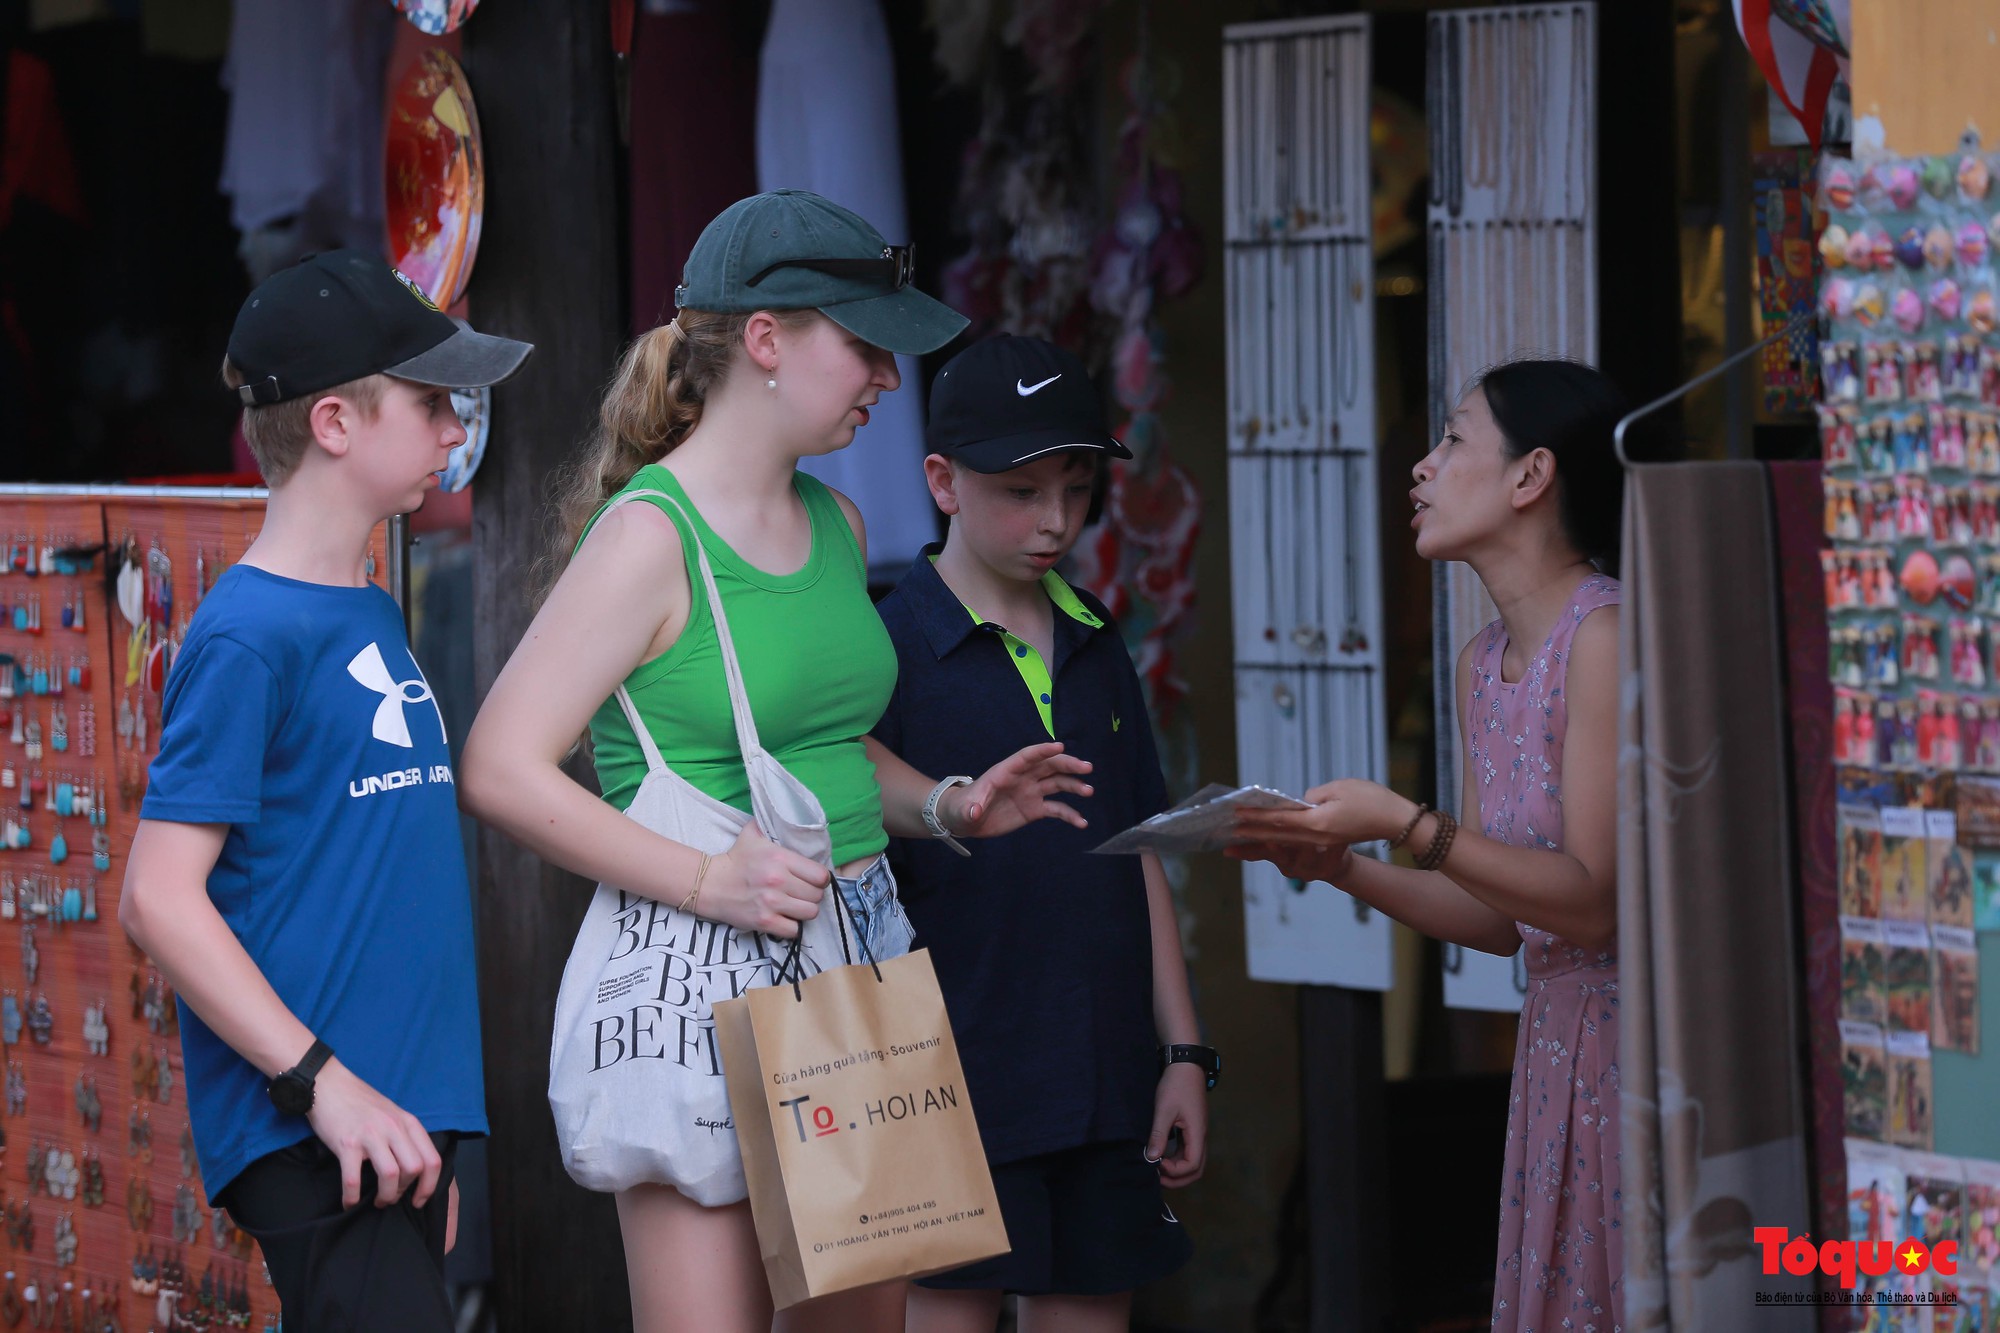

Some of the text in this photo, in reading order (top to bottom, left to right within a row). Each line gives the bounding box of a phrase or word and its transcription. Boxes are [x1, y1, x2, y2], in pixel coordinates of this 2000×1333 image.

[350, 768, 422, 798] UNDER
[587, 1004, 665, 1074] BE
[799, 1065, 831, 1079] hàng
[889, 1036, 941, 1056] Souvenir
[694, 1116, 735, 1136] Supré
[906, 1203, 921, 1213] 404
[922, 1200, 937, 1210] 495
[967, 1207, 985, 1218] NAM
